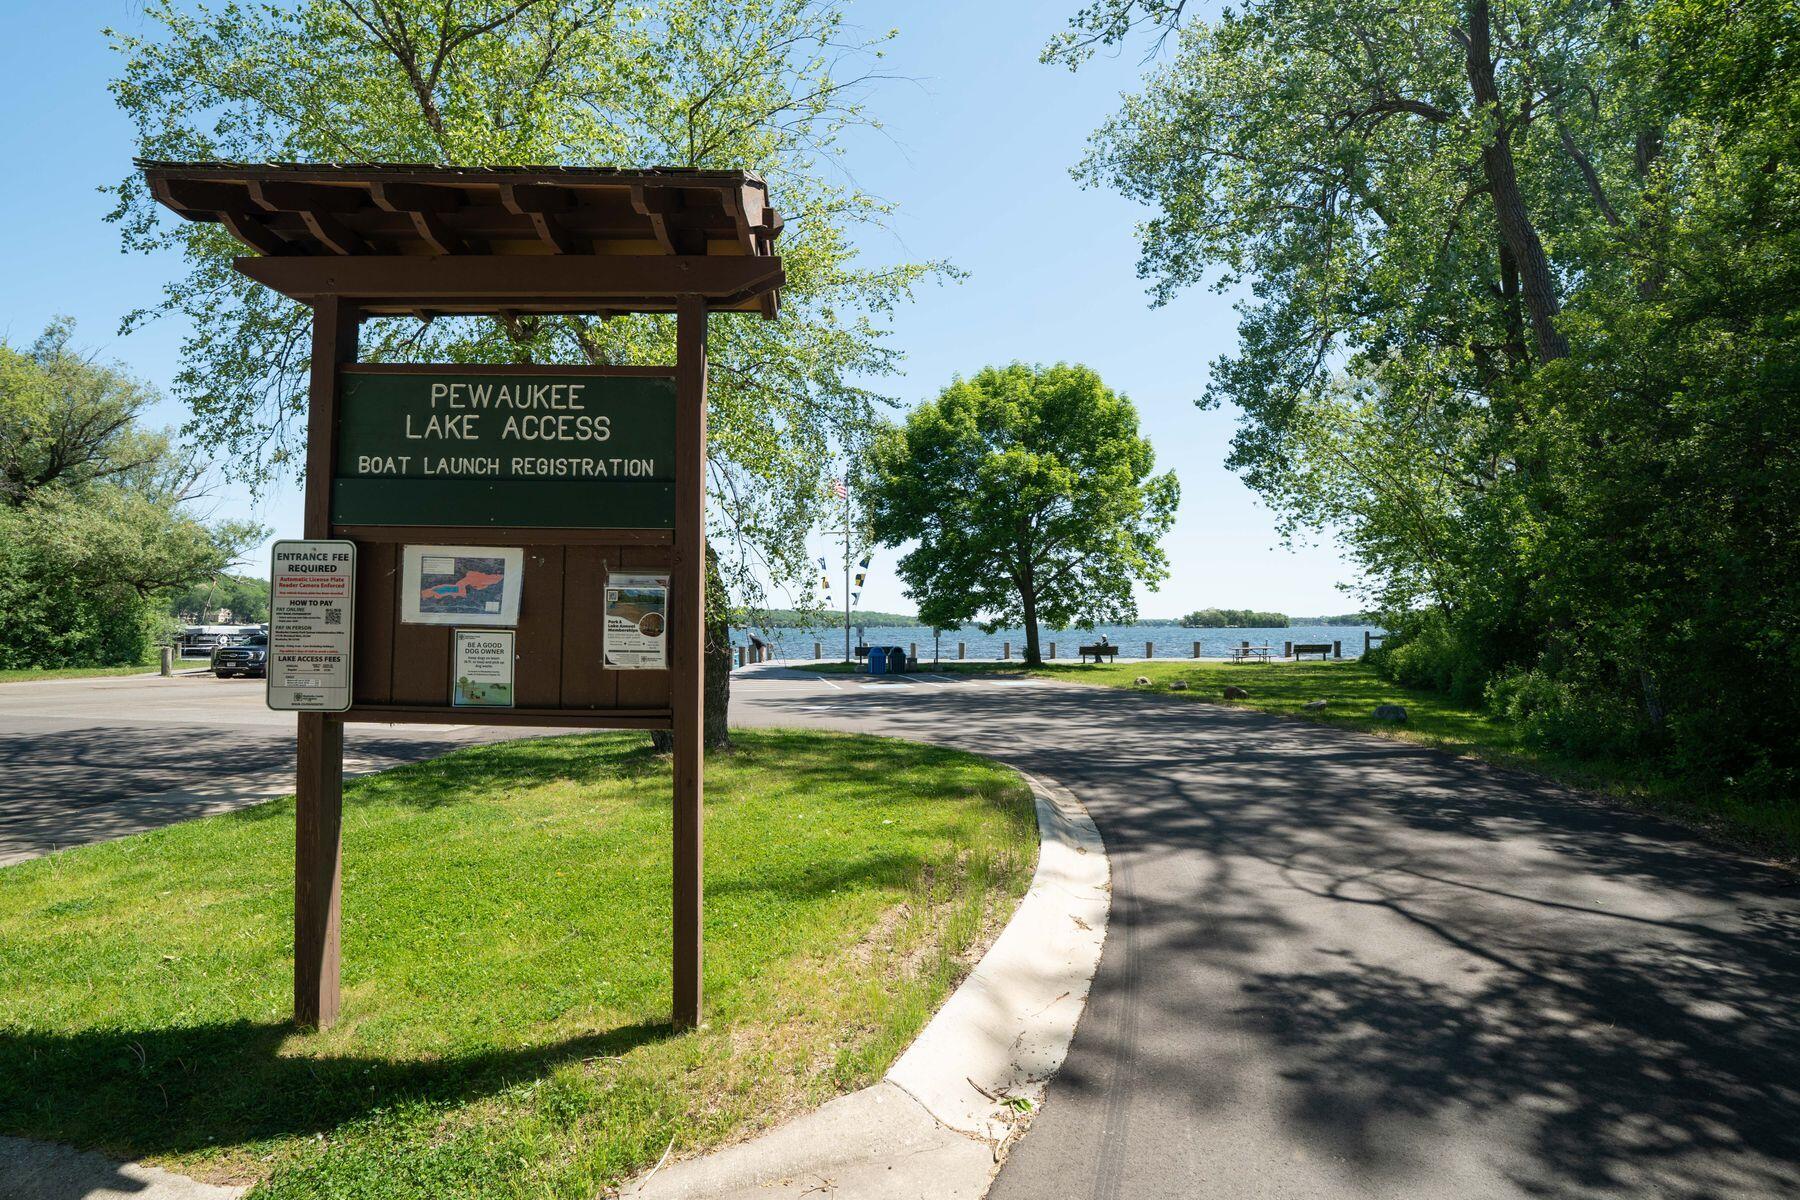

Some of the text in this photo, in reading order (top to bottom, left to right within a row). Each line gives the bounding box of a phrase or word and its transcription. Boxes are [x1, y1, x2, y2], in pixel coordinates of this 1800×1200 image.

[431, 383, 586, 410] PEWAUKEE
[406, 414, 610, 441] LAKE ACCESS
[358, 456, 654, 477] BOAT LAUNCH REGISTRATION
[277, 552, 349, 561] ENTRANCE FEE
[288, 564, 337, 573] REQUIRED
